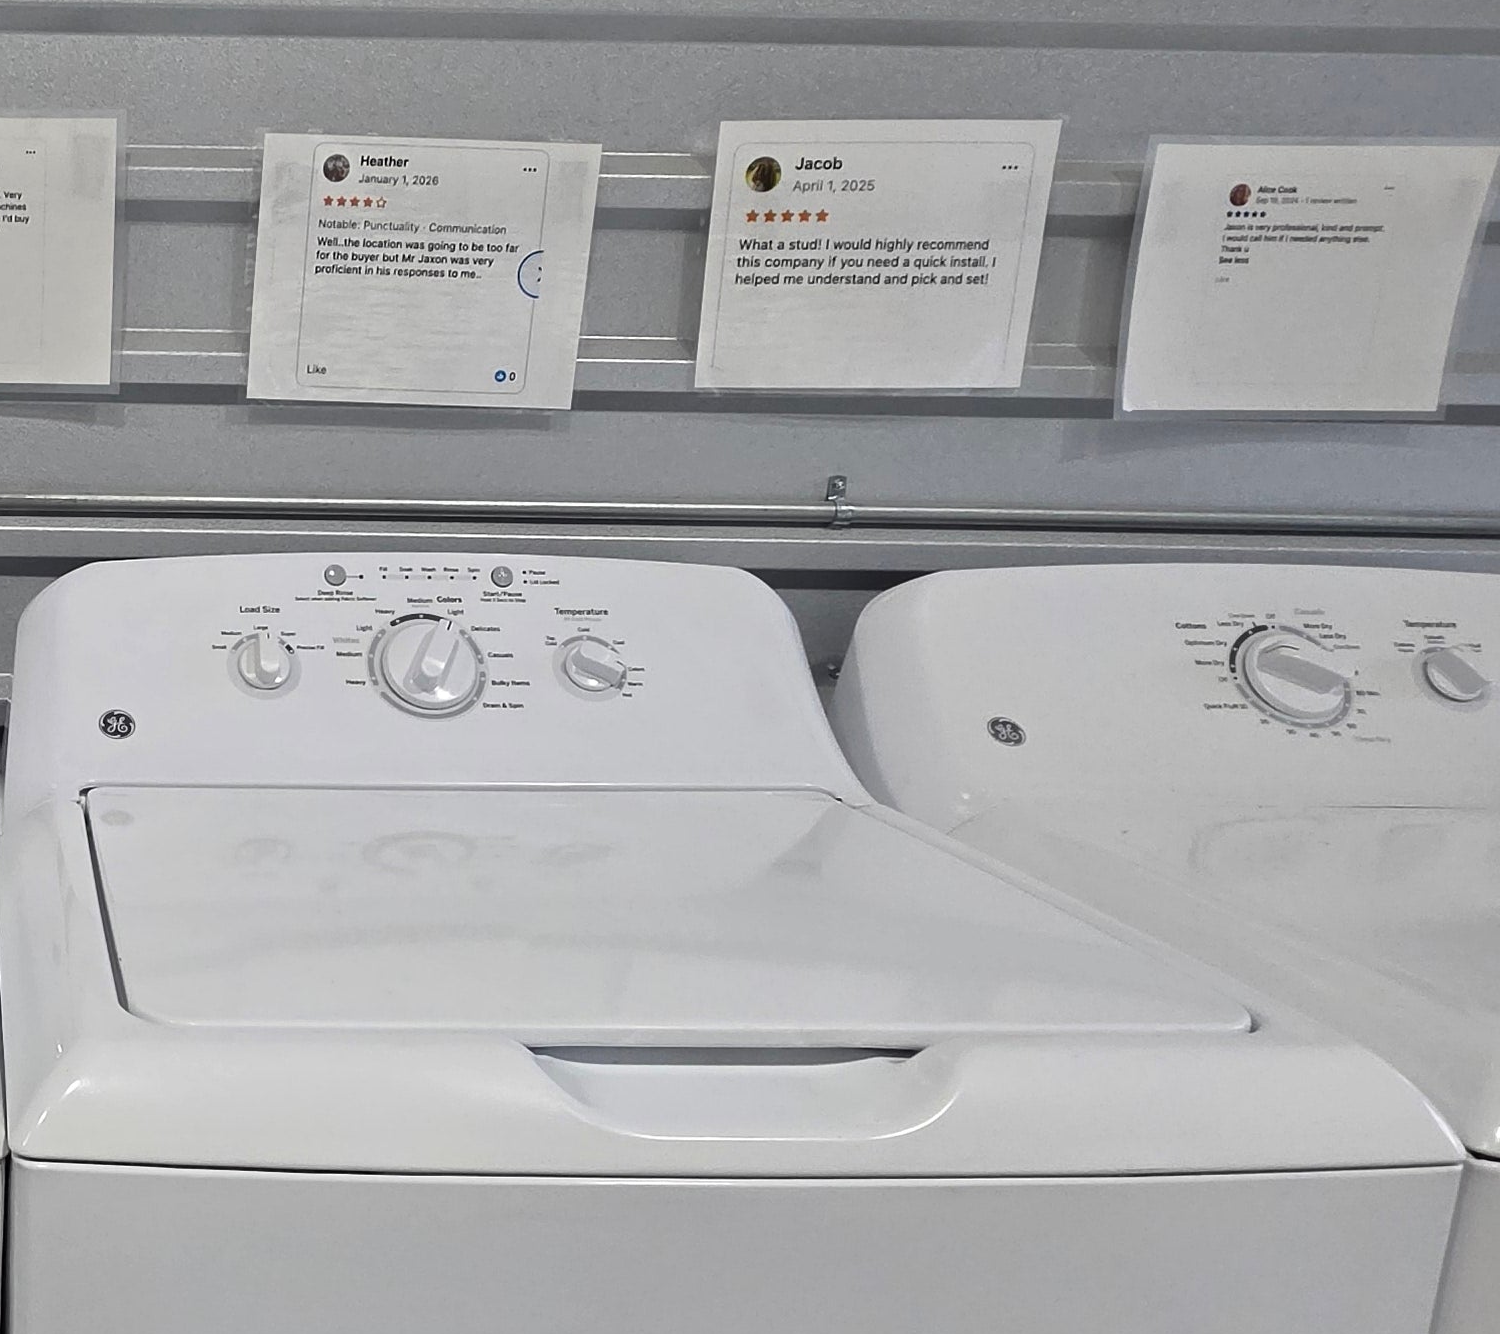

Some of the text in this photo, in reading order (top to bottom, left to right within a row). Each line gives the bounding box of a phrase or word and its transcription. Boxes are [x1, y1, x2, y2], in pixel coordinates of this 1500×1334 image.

[360, 155, 409, 167] Heather
[795, 157, 843, 170] Jacob
[358, 174, 399, 186] January
[402, 175, 409, 186] 1,
[792, 179, 875, 194] April 1, 2025
[363, 238, 402, 248] location
[405, 242, 425, 250] was
[428, 241, 456, 253] going
[459, 242, 469, 251] to
[471, 242, 484, 252] be
[487, 244, 503, 253] too
[505, 243, 519, 253] far
[739, 238, 990, 253] What a stud! I would highly recommend
[316, 250, 494, 267] for the buyer but Mr Jaxon was very
[737, 256, 761, 267] this
[764, 258, 825, 270] company
[828, 255, 837, 267] if
[840, 258, 864, 270] you
[867, 256, 900, 267] need
[902, 259, 910, 267] a
[914, 256, 947, 270] quick
[992, 257, 996, 267] I
[735, 273, 989, 287] helped me understand and pick and set!
[554, 607, 608, 616] Temperature
